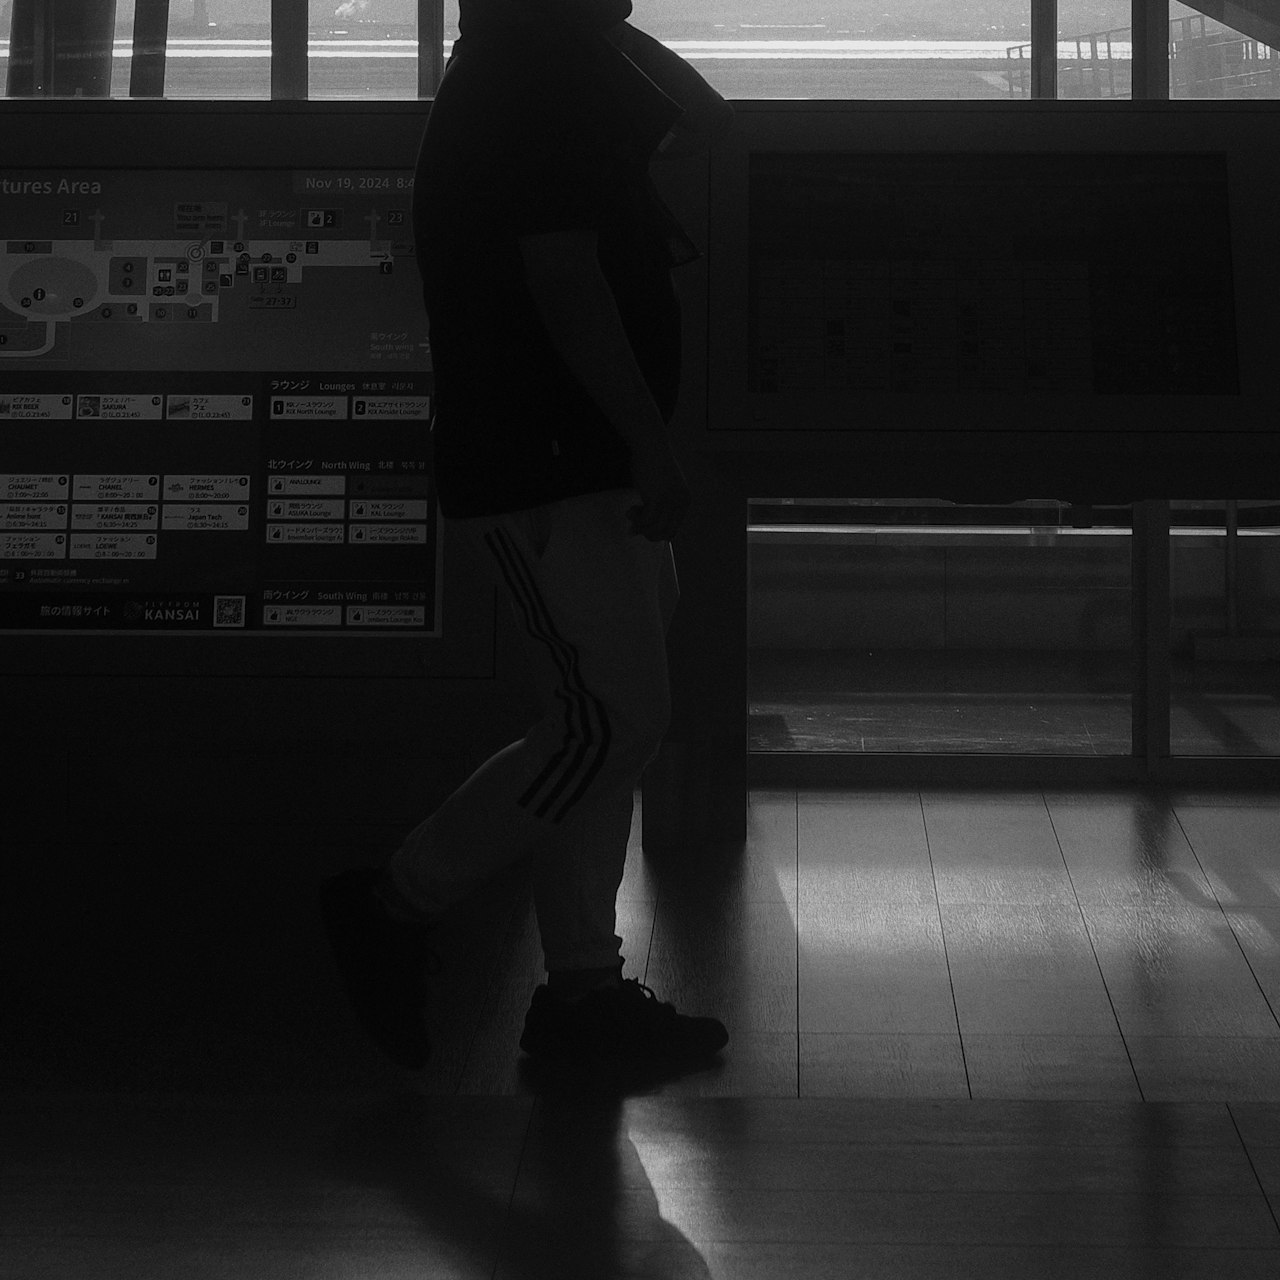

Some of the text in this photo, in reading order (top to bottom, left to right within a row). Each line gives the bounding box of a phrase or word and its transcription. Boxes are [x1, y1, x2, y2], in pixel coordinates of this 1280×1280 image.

[56, 177, 102, 195] Area
[305, 177, 415, 191] Nov 19, 2024 8:4
[63, 211, 79, 223] 21
[388, 212, 403, 223] 23
[271, 379, 311, 391] ラウンジ
[319, 382, 356, 393] Lounges
[267, 459, 371, 472] 北ウイング North Wing
[188, 514, 207, 522] Japan
[263, 589, 369, 603] 南ウイング South Wing
[39, 604, 112, 618] 旅の情報サイト
[144, 609, 200, 621] KANSAI
